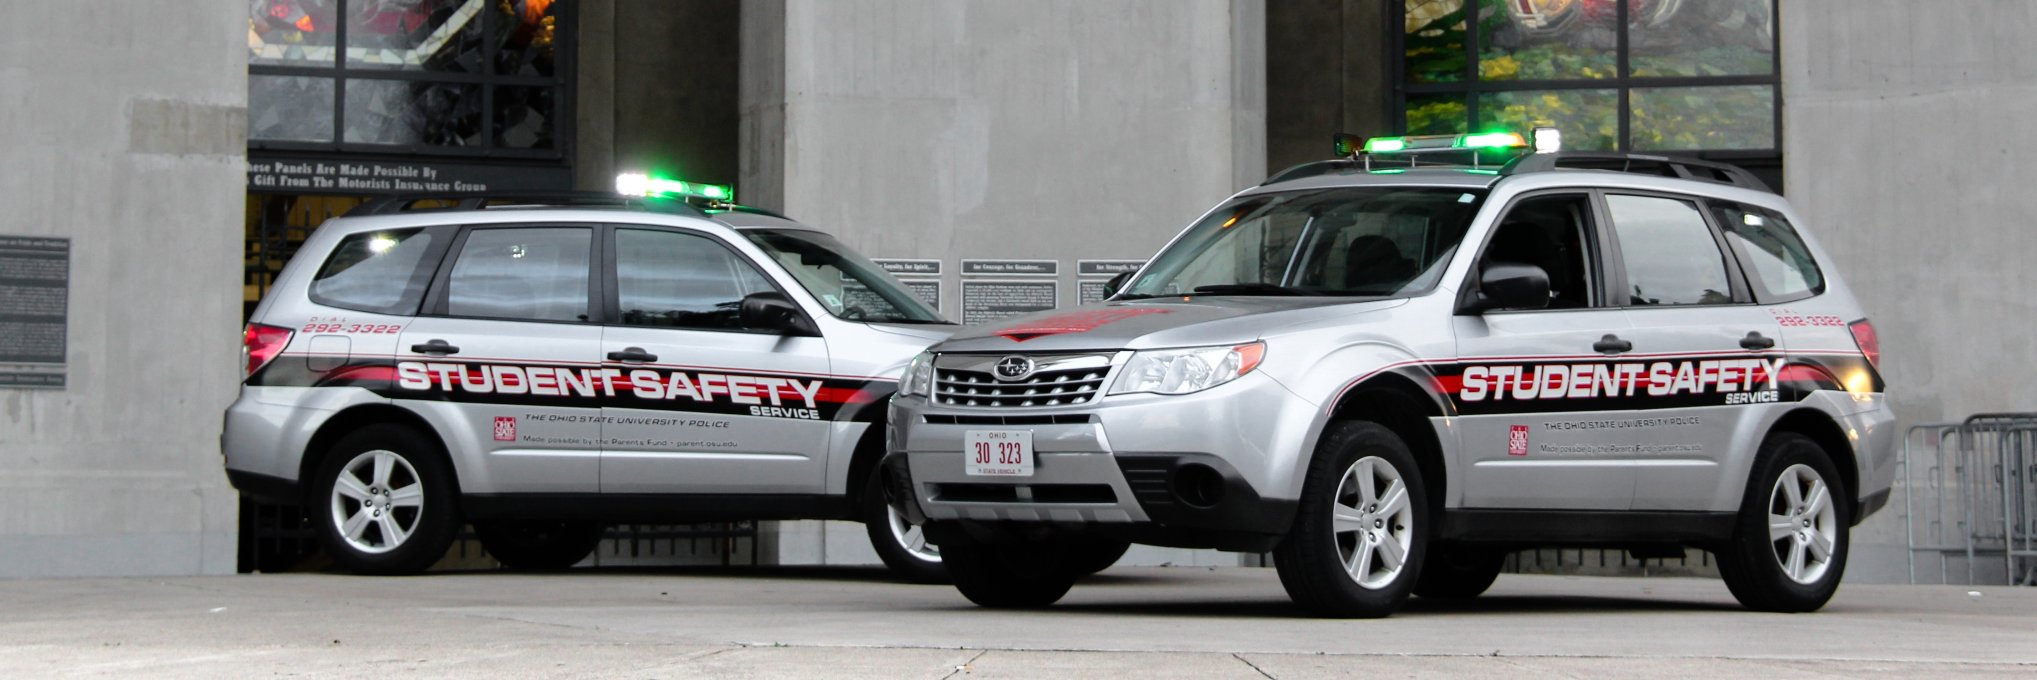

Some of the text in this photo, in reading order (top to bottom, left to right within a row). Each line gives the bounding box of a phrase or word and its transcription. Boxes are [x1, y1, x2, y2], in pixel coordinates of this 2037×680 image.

[247, 162, 437, 180] hese Panels Are Made Possible By
[254, 174, 276, 186] Gift
[280, 175, 310, 187] From
[313, 176, 334, 188] The
[338, 177, 391, 190] Motorists
[395, 179, 450, 191] Insuance
[302, 323, 401, 334] 292-3322
[1775, 315, 1845, 327] 292-3322
[397, 361, 824, 409] STUDENT SAFETY
[1460, 357, 1785, 401] STUDENT SAFETY
[1725, 390, 1779, 405] SERVICE
[749, 405, 821, 420] SERVICE
[494, 420, 516, 429] OHIO
[525, 413, 730, 429] THE OHIO STATE UNIVERSITY POLICE
[1544, 416, 1700, 431] THE OHIO STATE UNIVERSITY POLICE
[523, 435, 546, 443] Made
[1510, 430, 1527, 440] OHIO
[975, 442, 1022, 464] 30 323
